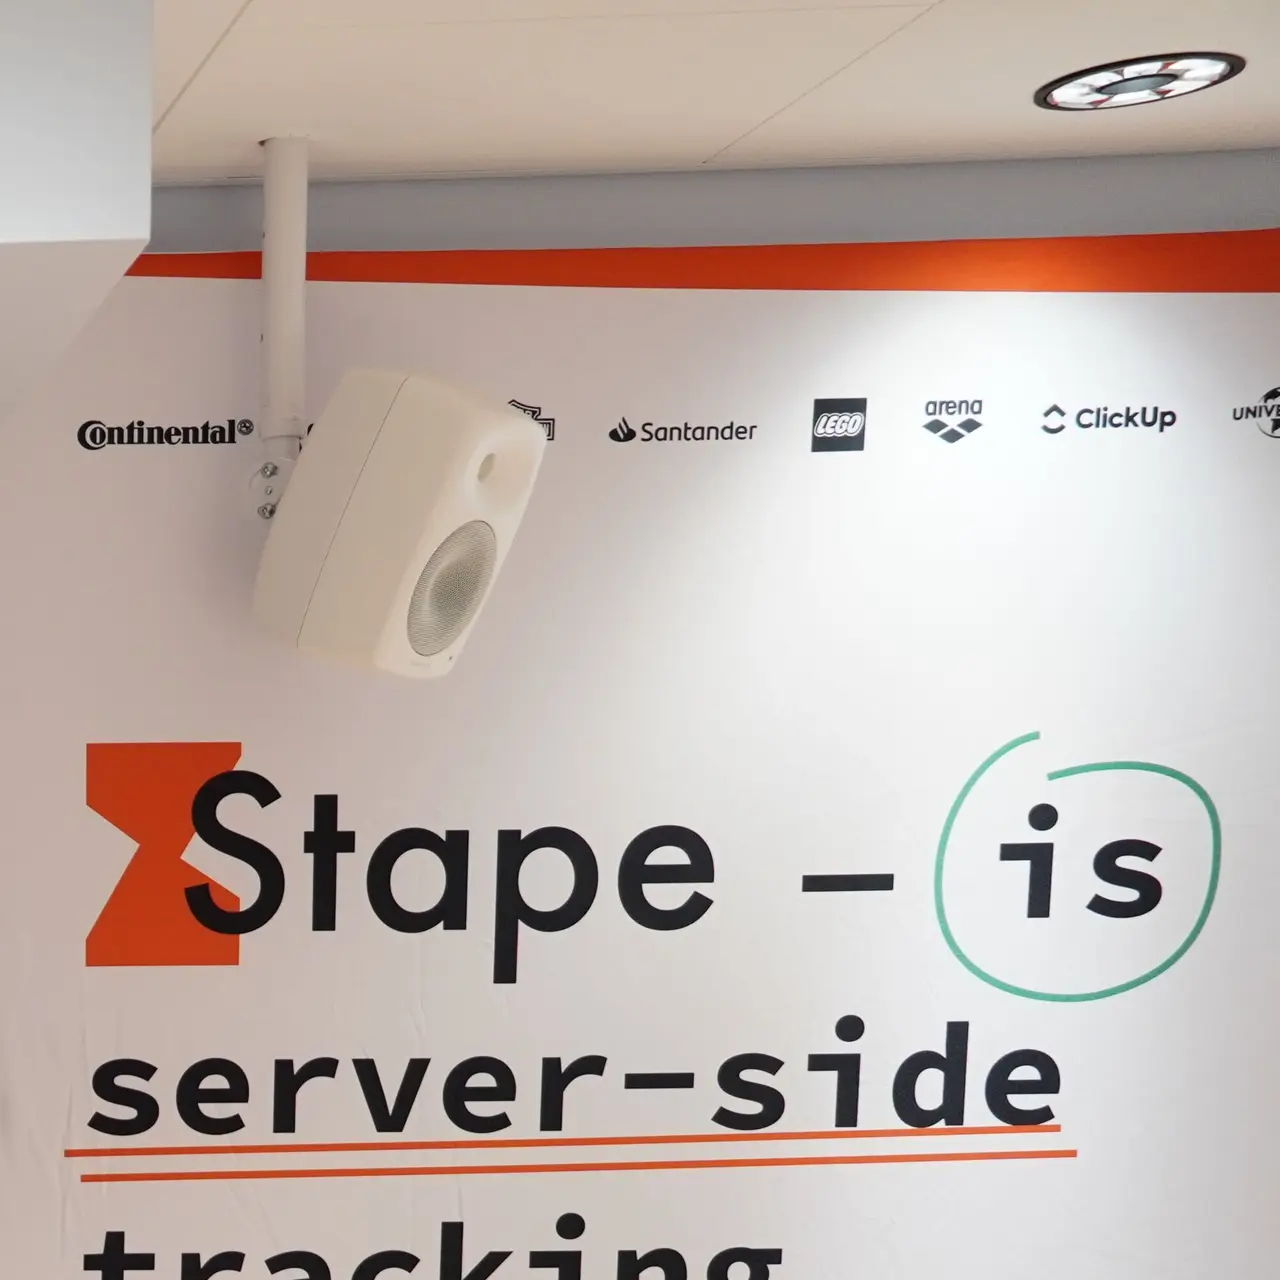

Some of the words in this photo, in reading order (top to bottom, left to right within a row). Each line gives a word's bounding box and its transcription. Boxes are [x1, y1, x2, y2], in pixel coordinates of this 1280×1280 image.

[925, 399, 983, 417] arena
[1076, 405, 1177, 433] ClickUp
[640, 421, 758, 442] Santander
[815, 412, 865, 437] LEGO
[183, 768, 716, 985] Stape
[998, 802, 1164, 920] is
[87, 1014, 1062, 1136] server-side
